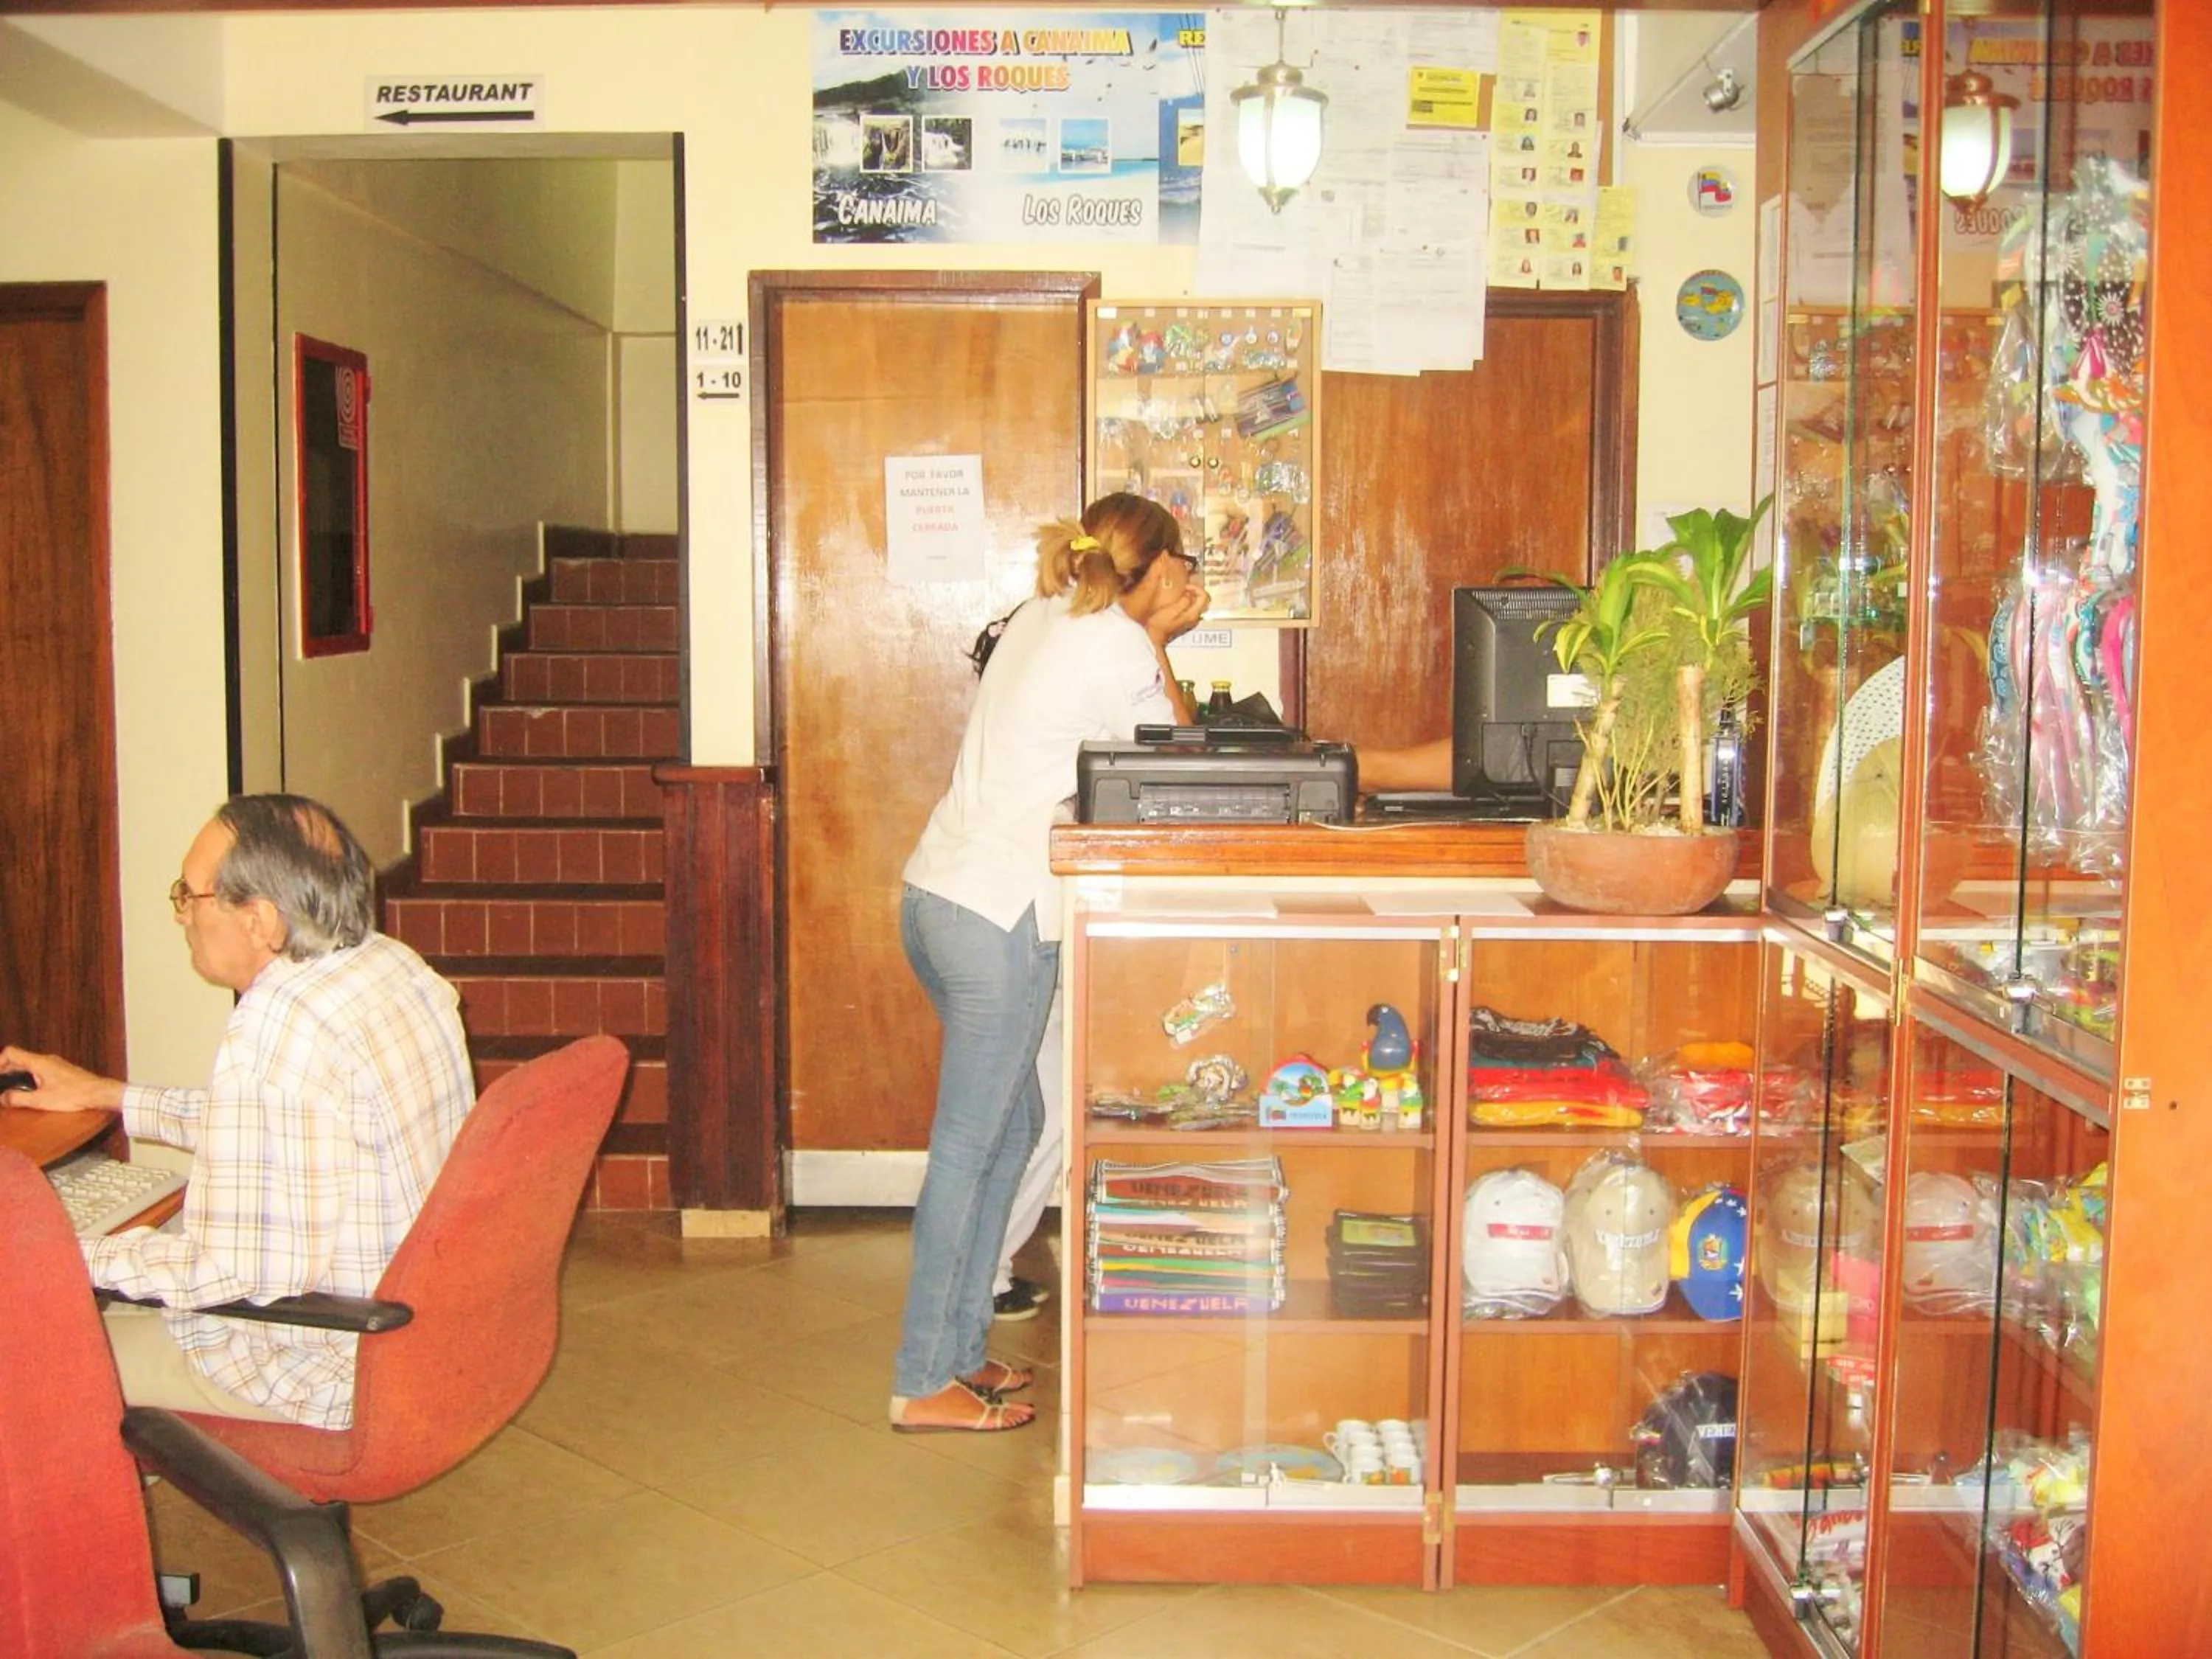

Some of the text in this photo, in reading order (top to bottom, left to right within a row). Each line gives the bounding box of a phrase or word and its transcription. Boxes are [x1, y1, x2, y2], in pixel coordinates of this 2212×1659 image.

[840, 29, 1133, 55] EXCURSIONES A CANAIMA
[905, 65, 1072, 94] Y LOS ROQUES
[376, 83, 533, 103] RESTAURANT
[838, 192, 937, 226] CANAIMA
[904, 469, 964, 481] POR FAVOR
[900, 487, 970, 497] MANTENER LA
[1124, 1296, 1251, 1311] VENEZUELA
